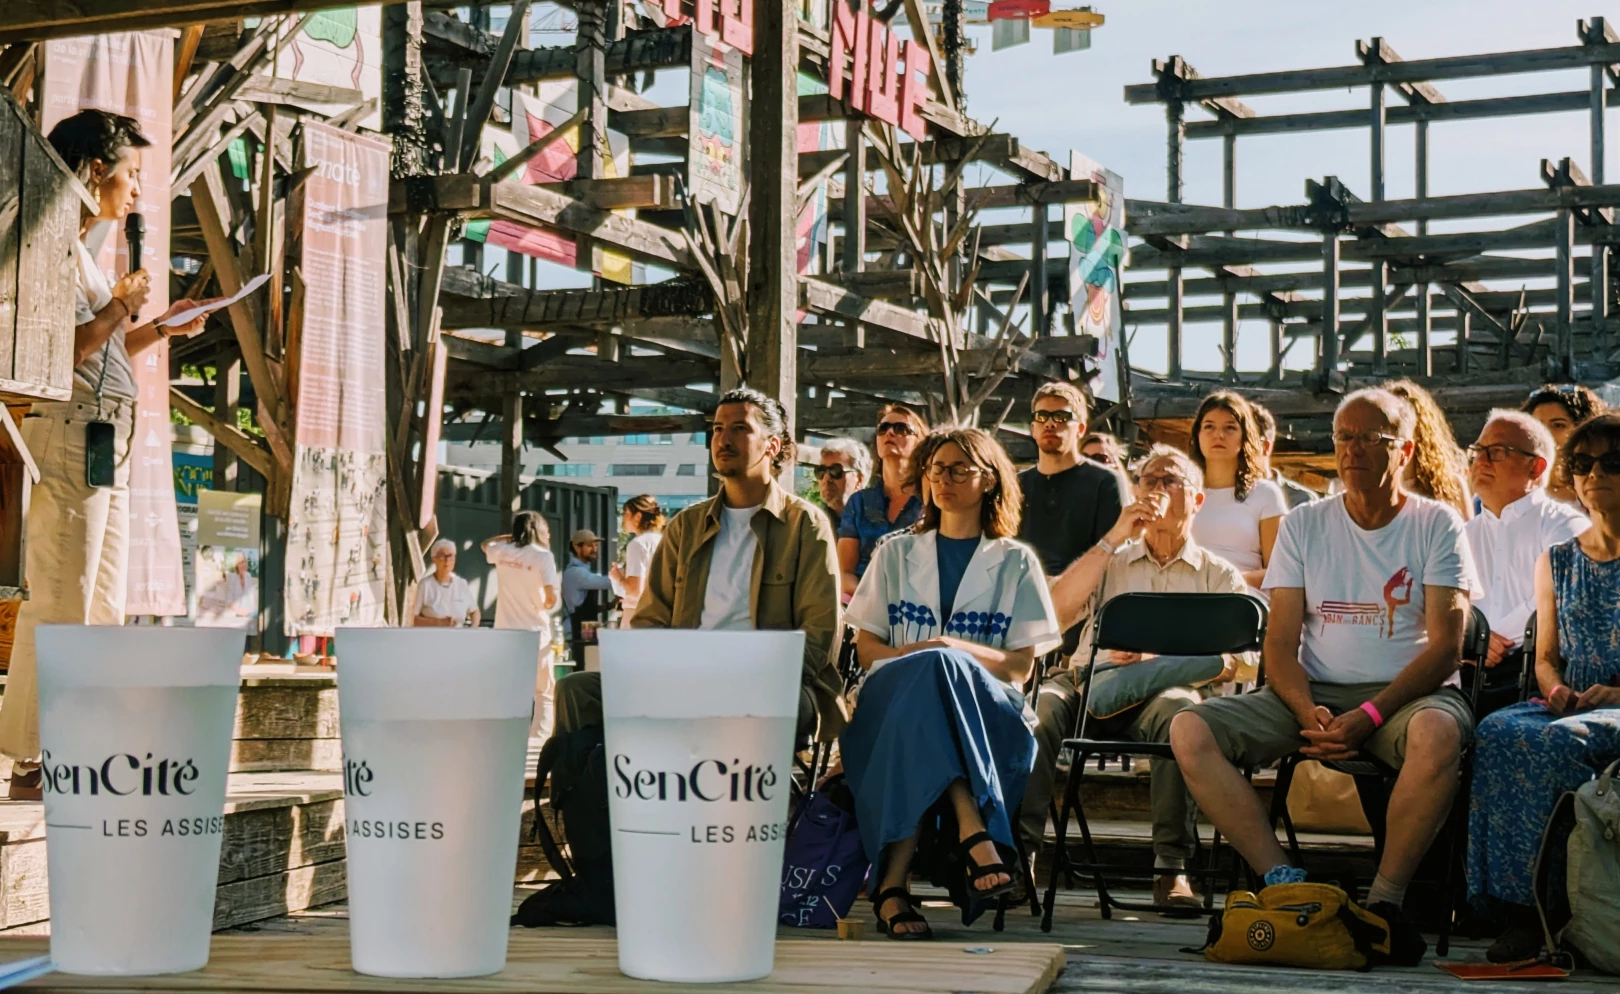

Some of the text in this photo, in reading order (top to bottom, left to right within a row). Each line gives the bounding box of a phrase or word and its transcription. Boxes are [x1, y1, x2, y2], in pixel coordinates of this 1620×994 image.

[42, 749, 199, 796] SenCité
[614, 754, 777, 802] SenCité
[103, 818, 148, 838] LES
[353, 819, 444, 840] ASSISES
[691, 825, 734, 843] LES
